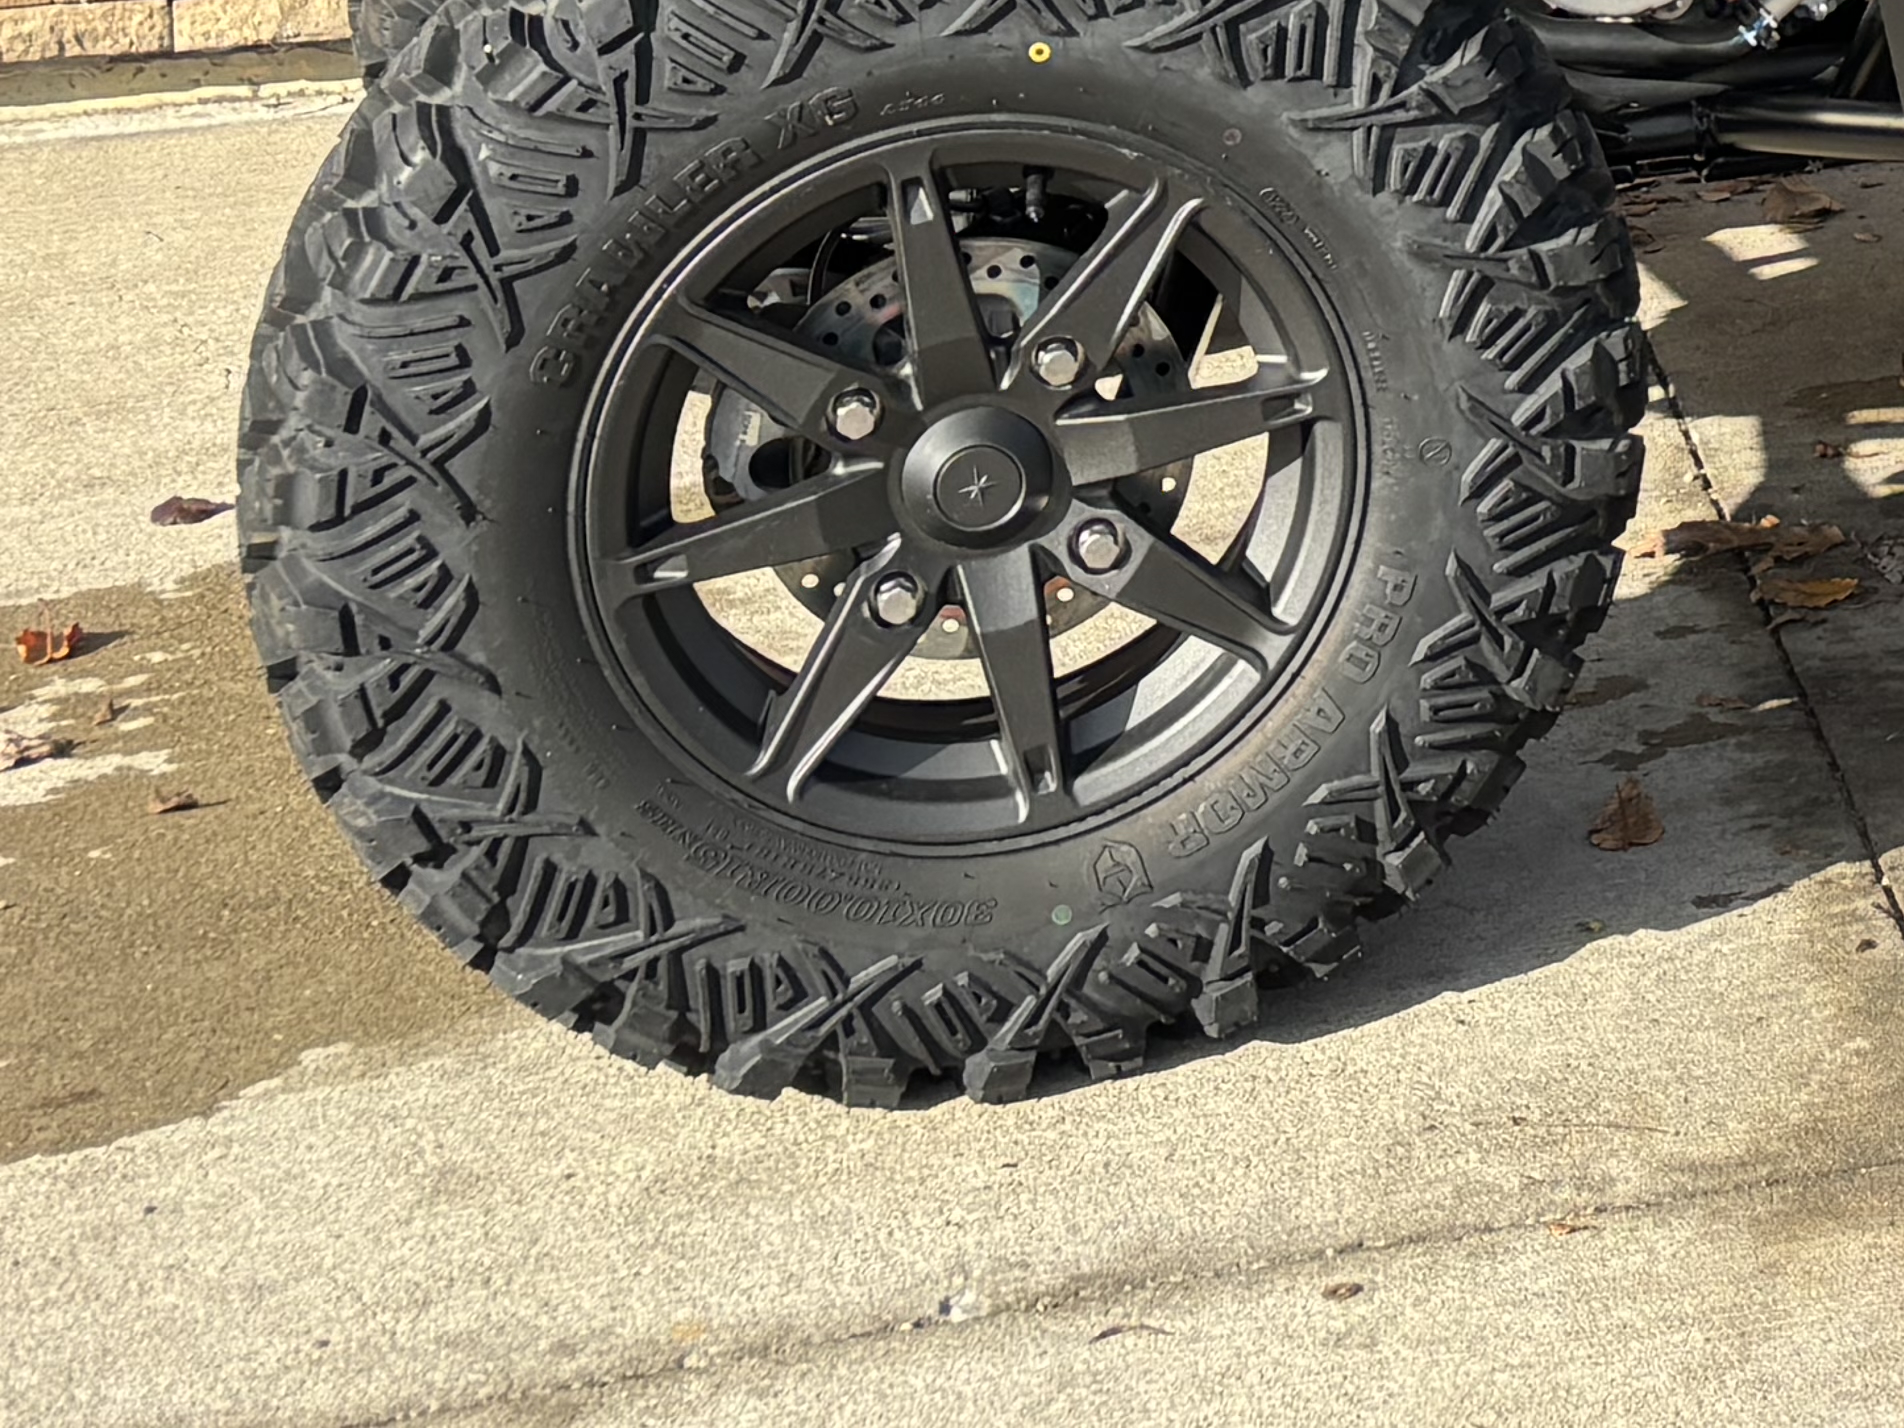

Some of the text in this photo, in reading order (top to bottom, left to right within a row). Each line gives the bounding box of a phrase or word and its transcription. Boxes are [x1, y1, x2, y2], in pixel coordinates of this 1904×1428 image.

[528, 136, 766, 387] CRAWLER
[1167, 563, 1418, 859] PRO ARMOR
